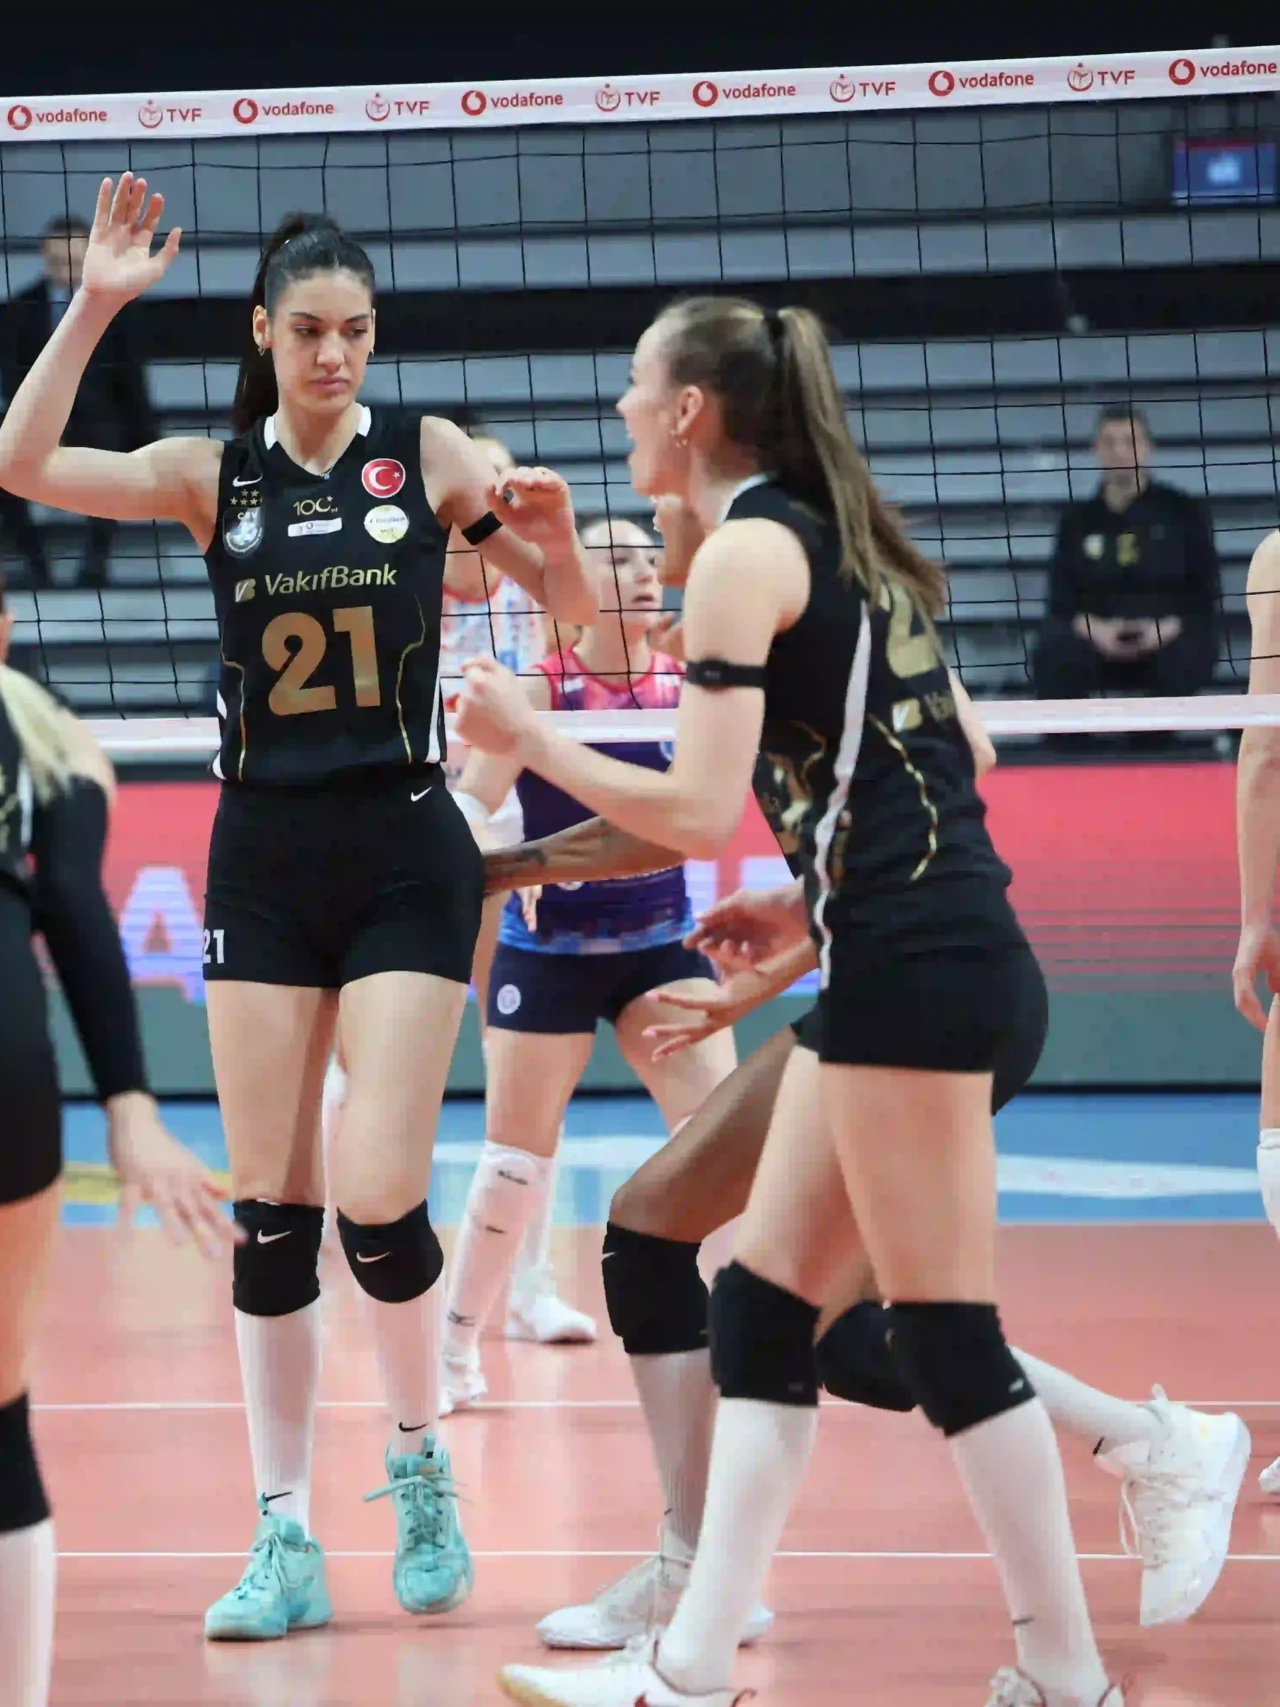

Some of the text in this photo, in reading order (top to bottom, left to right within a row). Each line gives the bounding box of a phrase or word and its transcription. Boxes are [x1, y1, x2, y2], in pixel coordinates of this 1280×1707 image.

[37, 108, 108, 123] vodafone
[169, 107, 200, 119] TVF
[264, 102, 335, 116] vodafone
[395, 100, 429, 112] TVF
[492, 94, 564, 108] vodafone
[625, 91, 661, 103] TVF
[722, 83, 797, 98] vodafone
[860, 80, 896, 93] TVF
[960, 72, 1034, 88] vodafone
[1098, 69, 1134, 83] TVF
[1200, 61, 1277, 77] vodafone
[265, 563, 397, 596] VakıfBank
[261, 605, 381, 716] 21
[203, 929, 225, 964] 21
